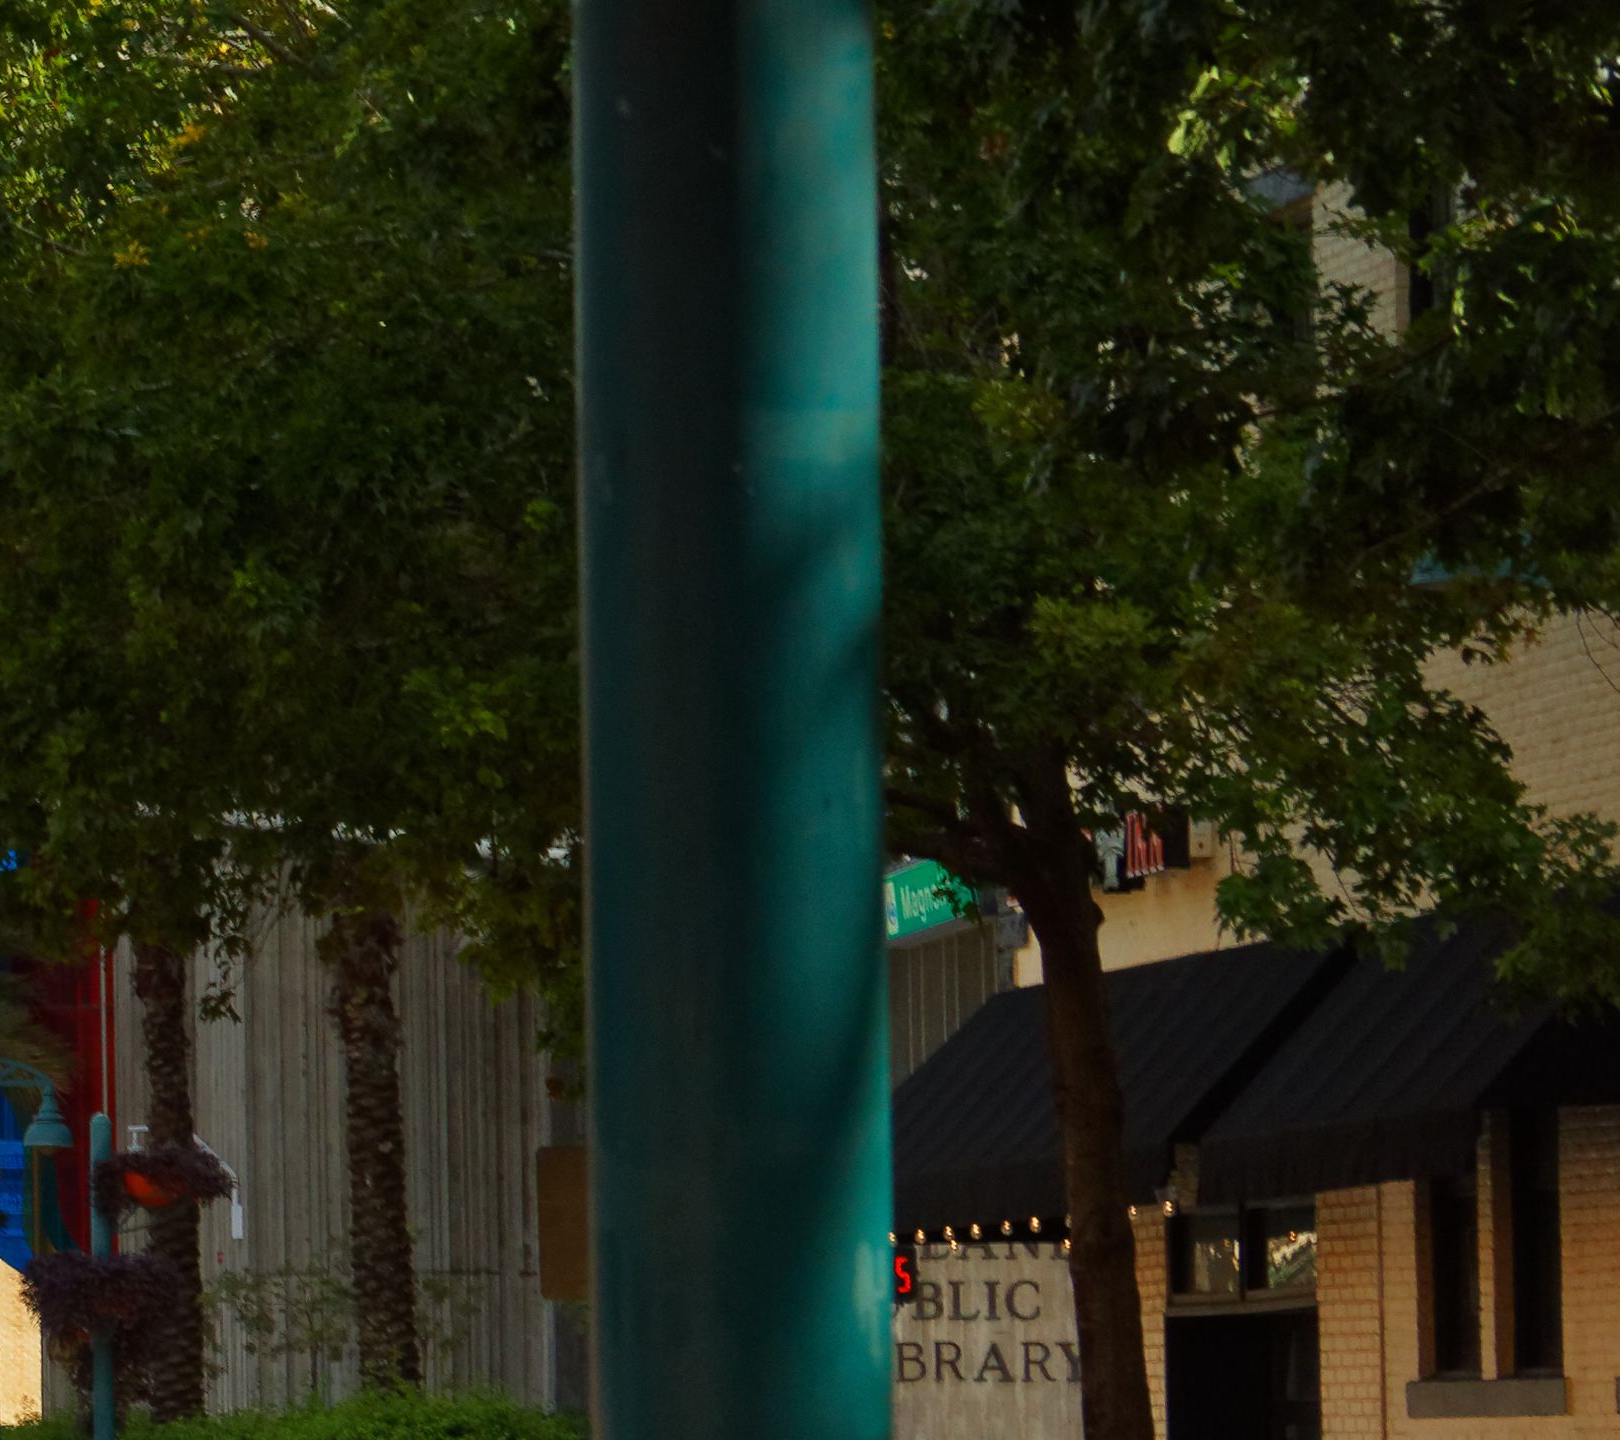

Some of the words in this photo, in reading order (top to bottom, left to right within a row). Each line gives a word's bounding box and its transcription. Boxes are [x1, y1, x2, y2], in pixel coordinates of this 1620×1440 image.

[894, 1255, 911, 1293] 5
[911, 1280, 1041, 1321] BLIC
[895, 1341, 1082, 1383] BRARY
